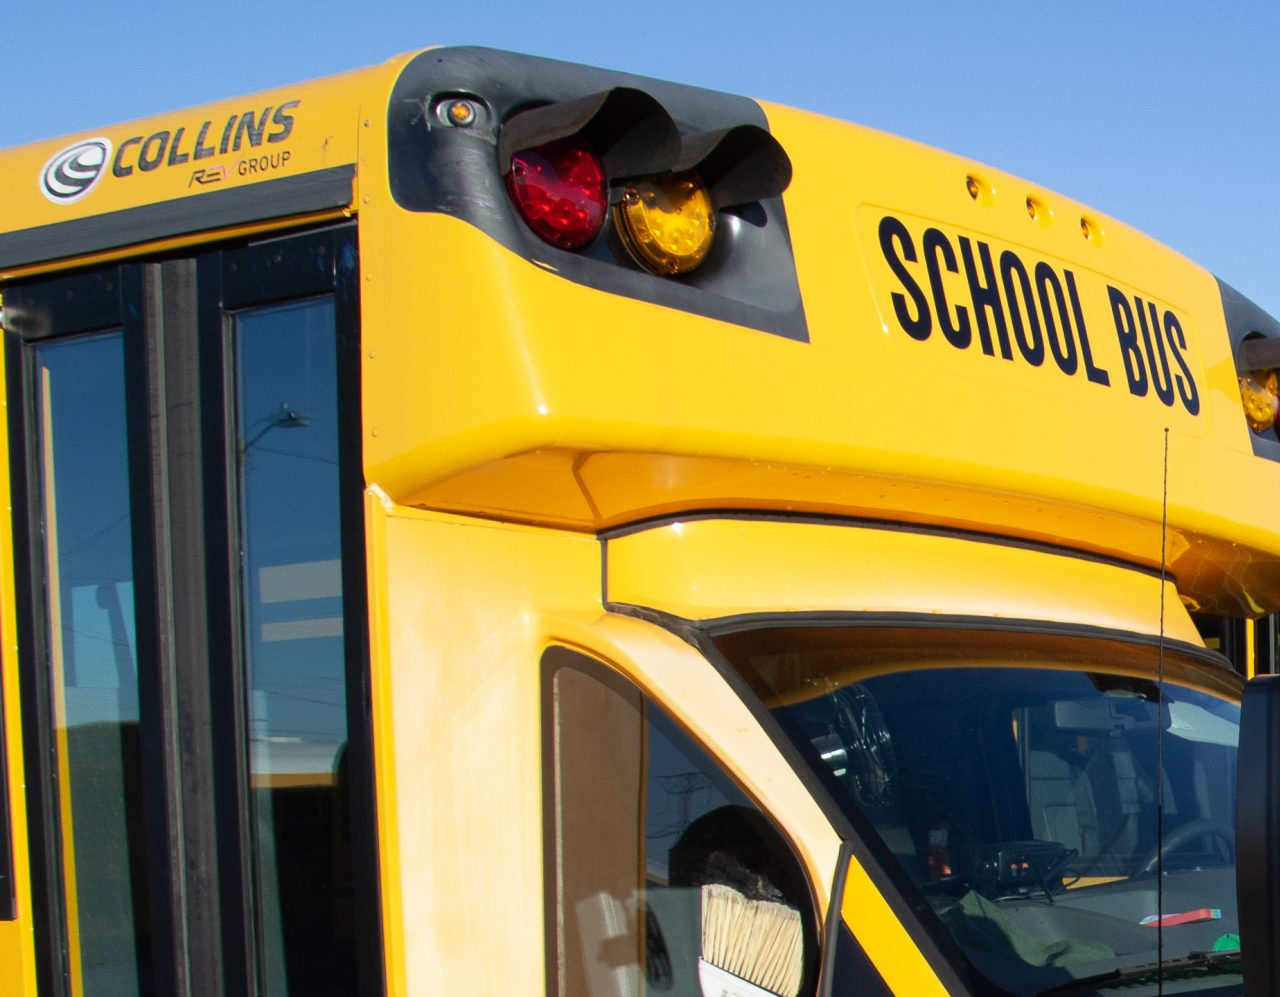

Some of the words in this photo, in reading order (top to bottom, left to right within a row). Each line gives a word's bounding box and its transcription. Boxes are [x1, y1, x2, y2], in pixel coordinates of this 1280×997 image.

[112, 100, 301, 178] COLLINS
[238, 151, 292, 177] GROUP
[878, 216, 1111, 387] SCHOOL
[1106, 284, 1200, 416] BUS
